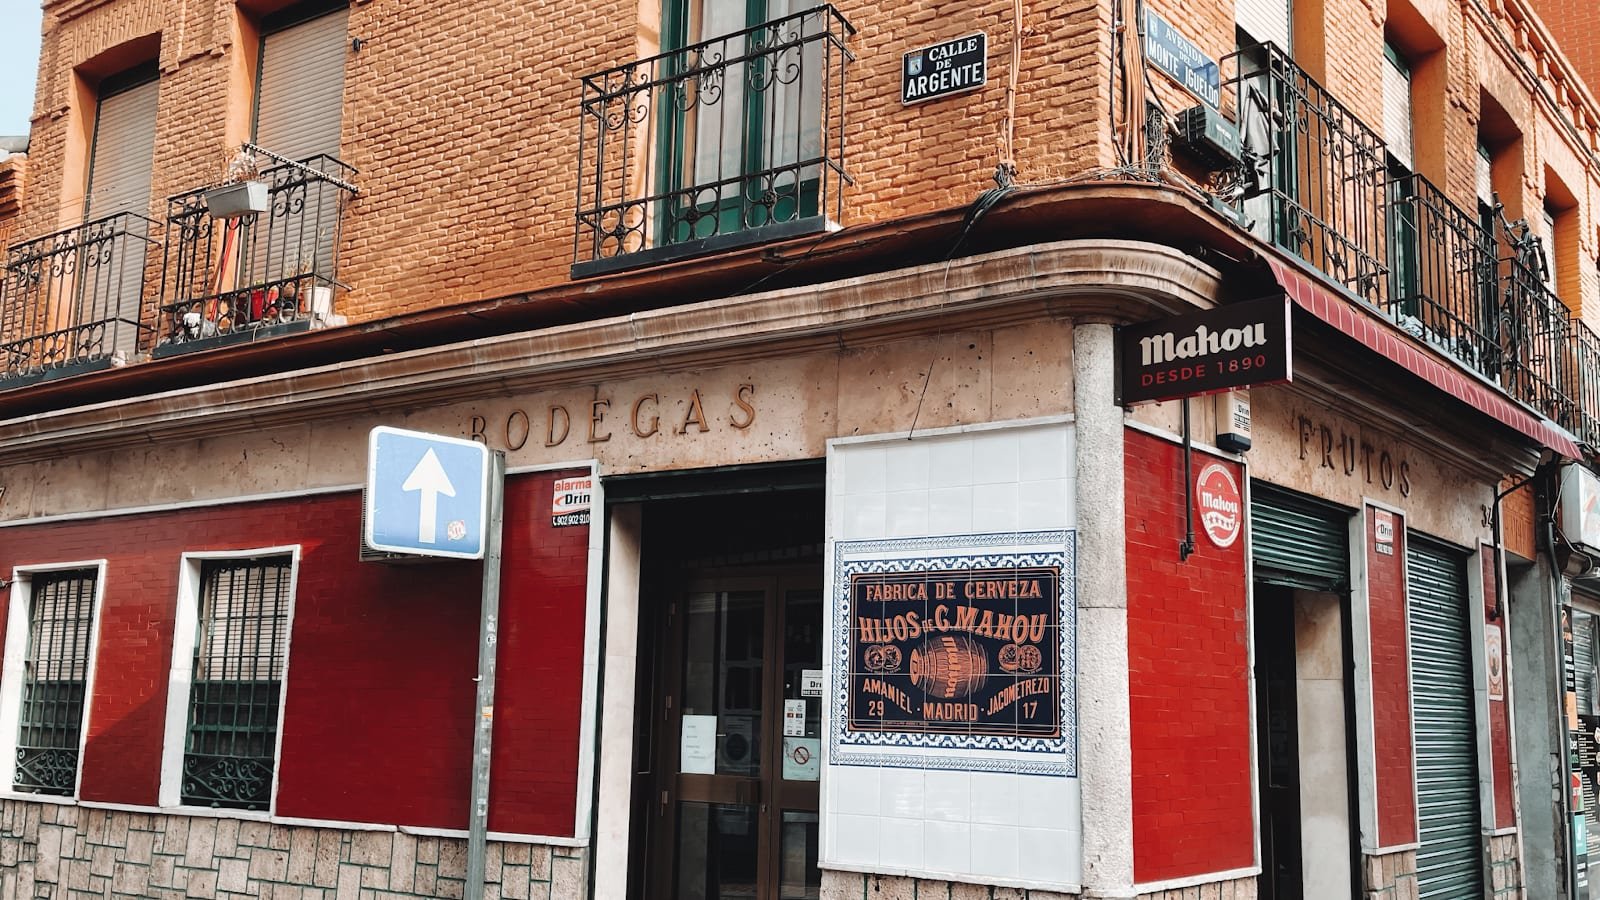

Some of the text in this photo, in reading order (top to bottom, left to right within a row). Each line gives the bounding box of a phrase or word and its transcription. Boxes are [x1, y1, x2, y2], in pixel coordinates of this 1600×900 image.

[928, 38, 978, 62] CALLE
[1165, 27, 1204, 67] AVENIDA
[1179, 50, 1192, 66] DEL
[936, 58, 952, 71] DE
[1148, 37, 1219, 108] MONTE IGUELDO
[906, 62, 982, 98] ARGENTE
[1139, 322, 1267, 366] Mahou
[1141, 354, 1266, 387] DESDE 1890
[469, 383, 756, 451] BODEGAS
[1298, 415, 1411, 499] FRUTOS
[555, 480, 591, 492] alarma
[565, 492, 590, 505] Drin
[1202, 491, 1239, 513] Mahou
[557, 515, 568, 526] 902
[568, 515, 579, 525] 902
[935, 582, 956, 600] DE
[964, 580, 1042, 599] CERVEZA
[859, 611, 921, 643] HIJOS
[921, 619, 935, 633] DE
[955, 605, 1048, 645] MAHOU
[810, 680, 822, 688] Dri
[862, 677, 1050, 722] AMANIEL MADRID JACOMETREZO
[868, 700, 1038, 719] 29 17
